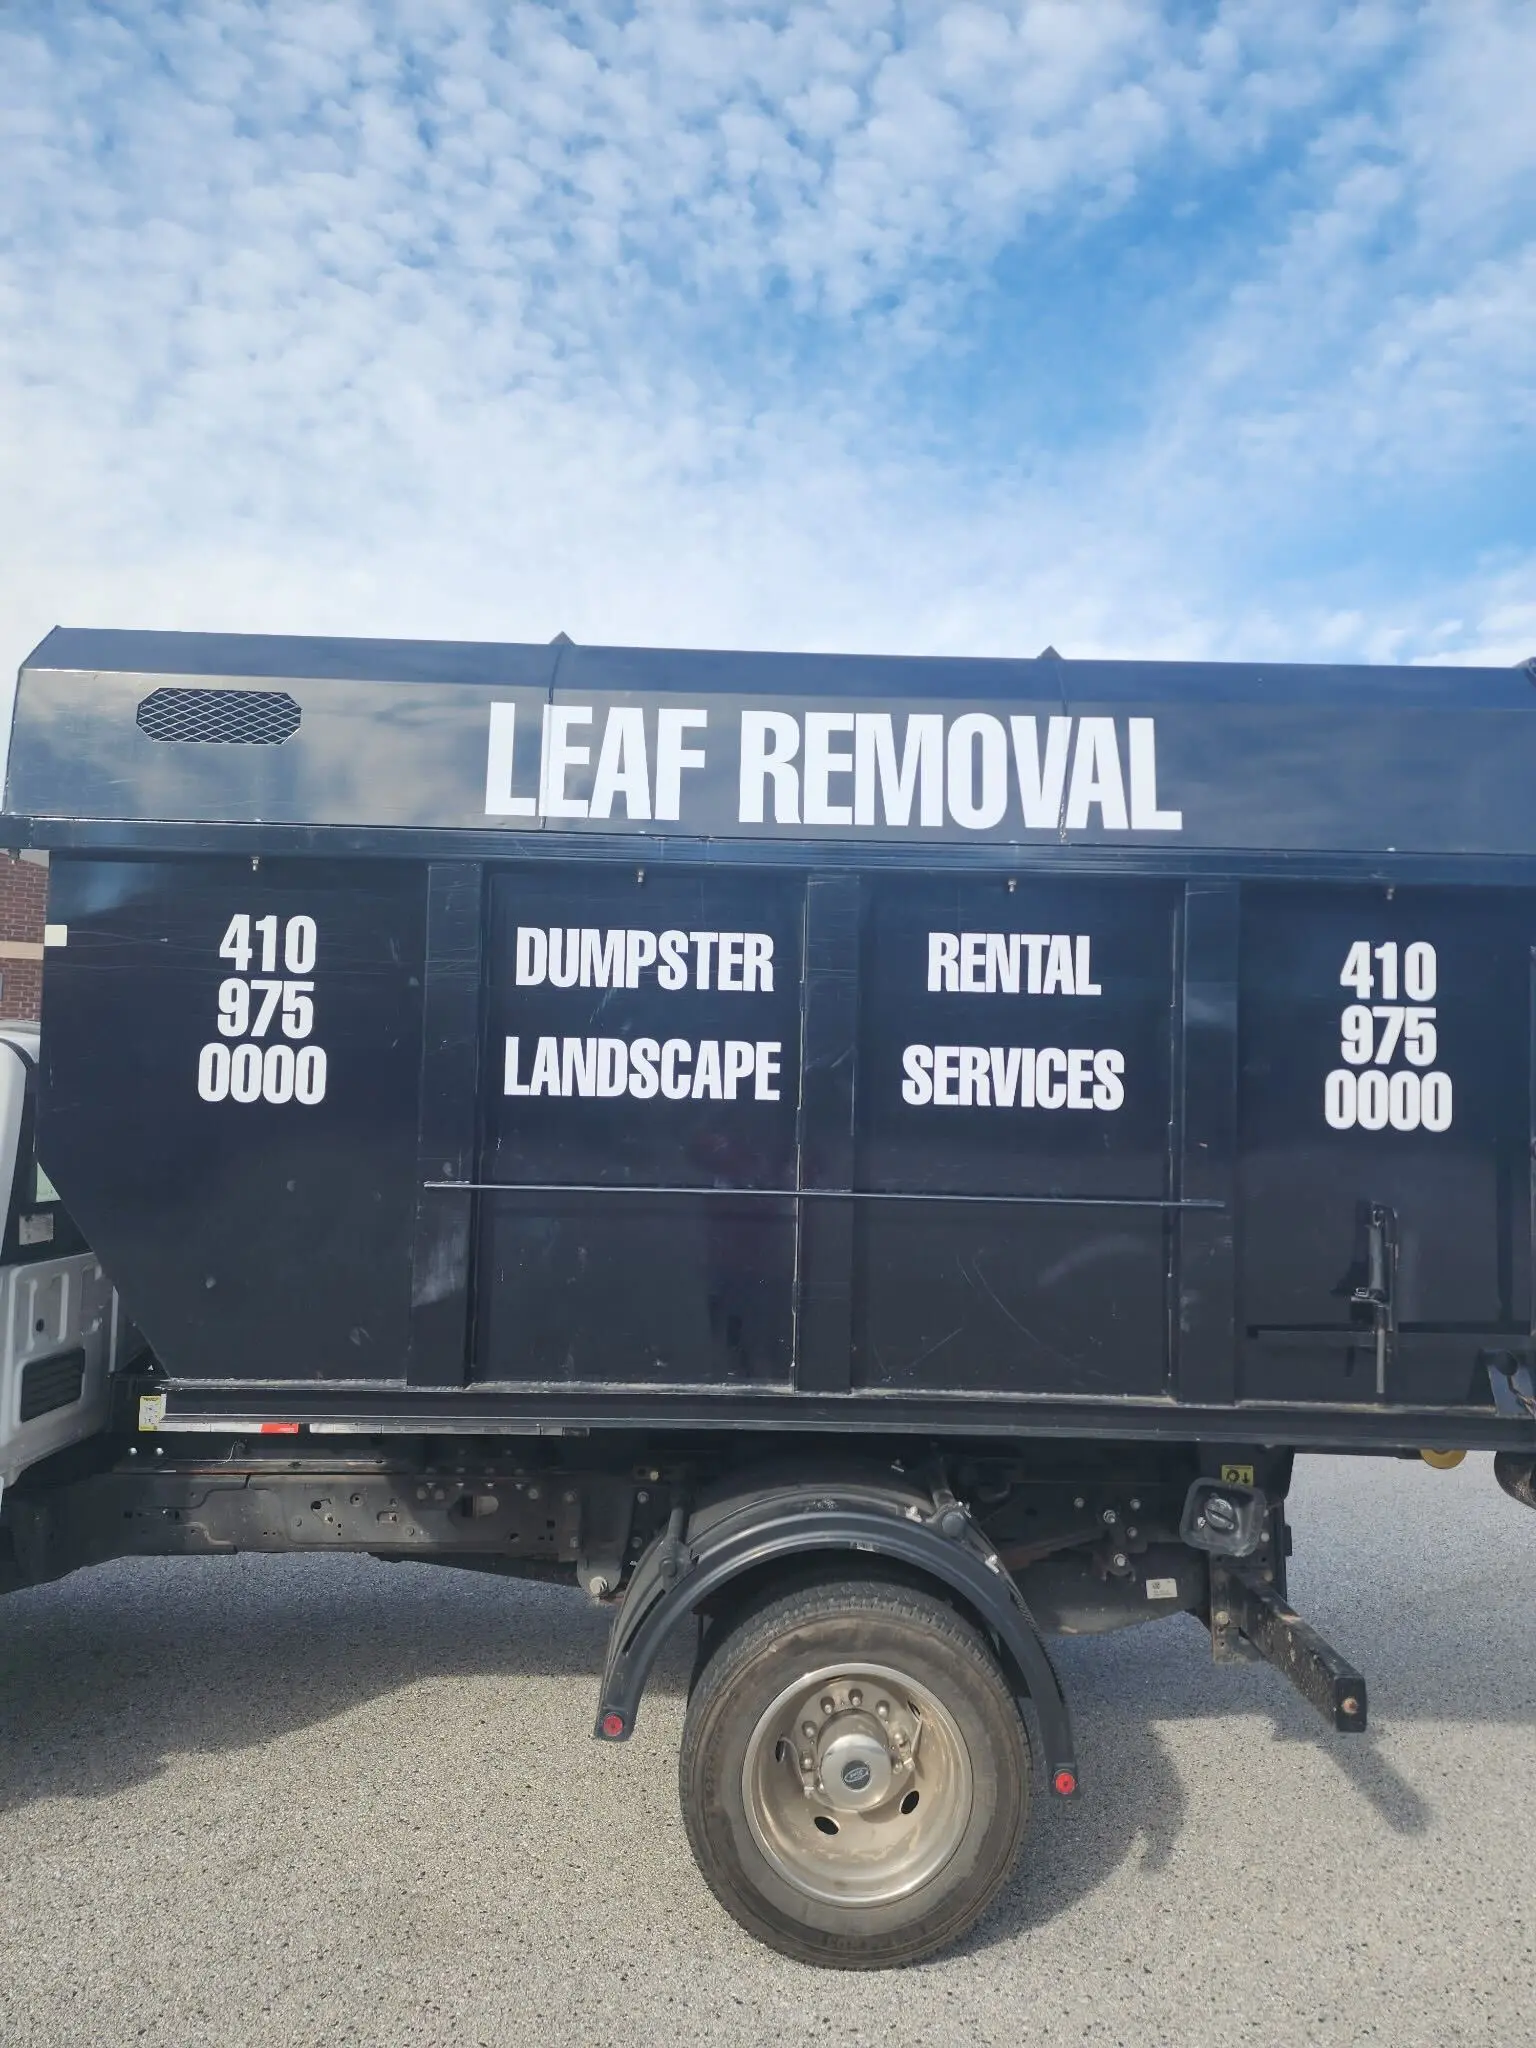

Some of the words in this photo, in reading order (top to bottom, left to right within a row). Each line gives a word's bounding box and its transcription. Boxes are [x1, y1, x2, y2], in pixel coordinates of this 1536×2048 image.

[485, 702, 709, 822] LEAF
[738, 710, 1182, 831] REMOVAL
[220, 914, 316, 973] 410
[516, 927, 775, 993] DUMPSTER
[928, 933, 1101, 995] RENTAL
[1341, 942, 1436, 1001] 410
[218, 979, 315, 1038] 975
[1342, 1006, 1436, 1066] 975
[198, 1043, 326, 1104] 0000
[504, 1037, 782, 1101] LANDSCAPE
[902, 1045, 1125, 1110] SERVICES
[1325, 1070, 1452, 1131] 0000
